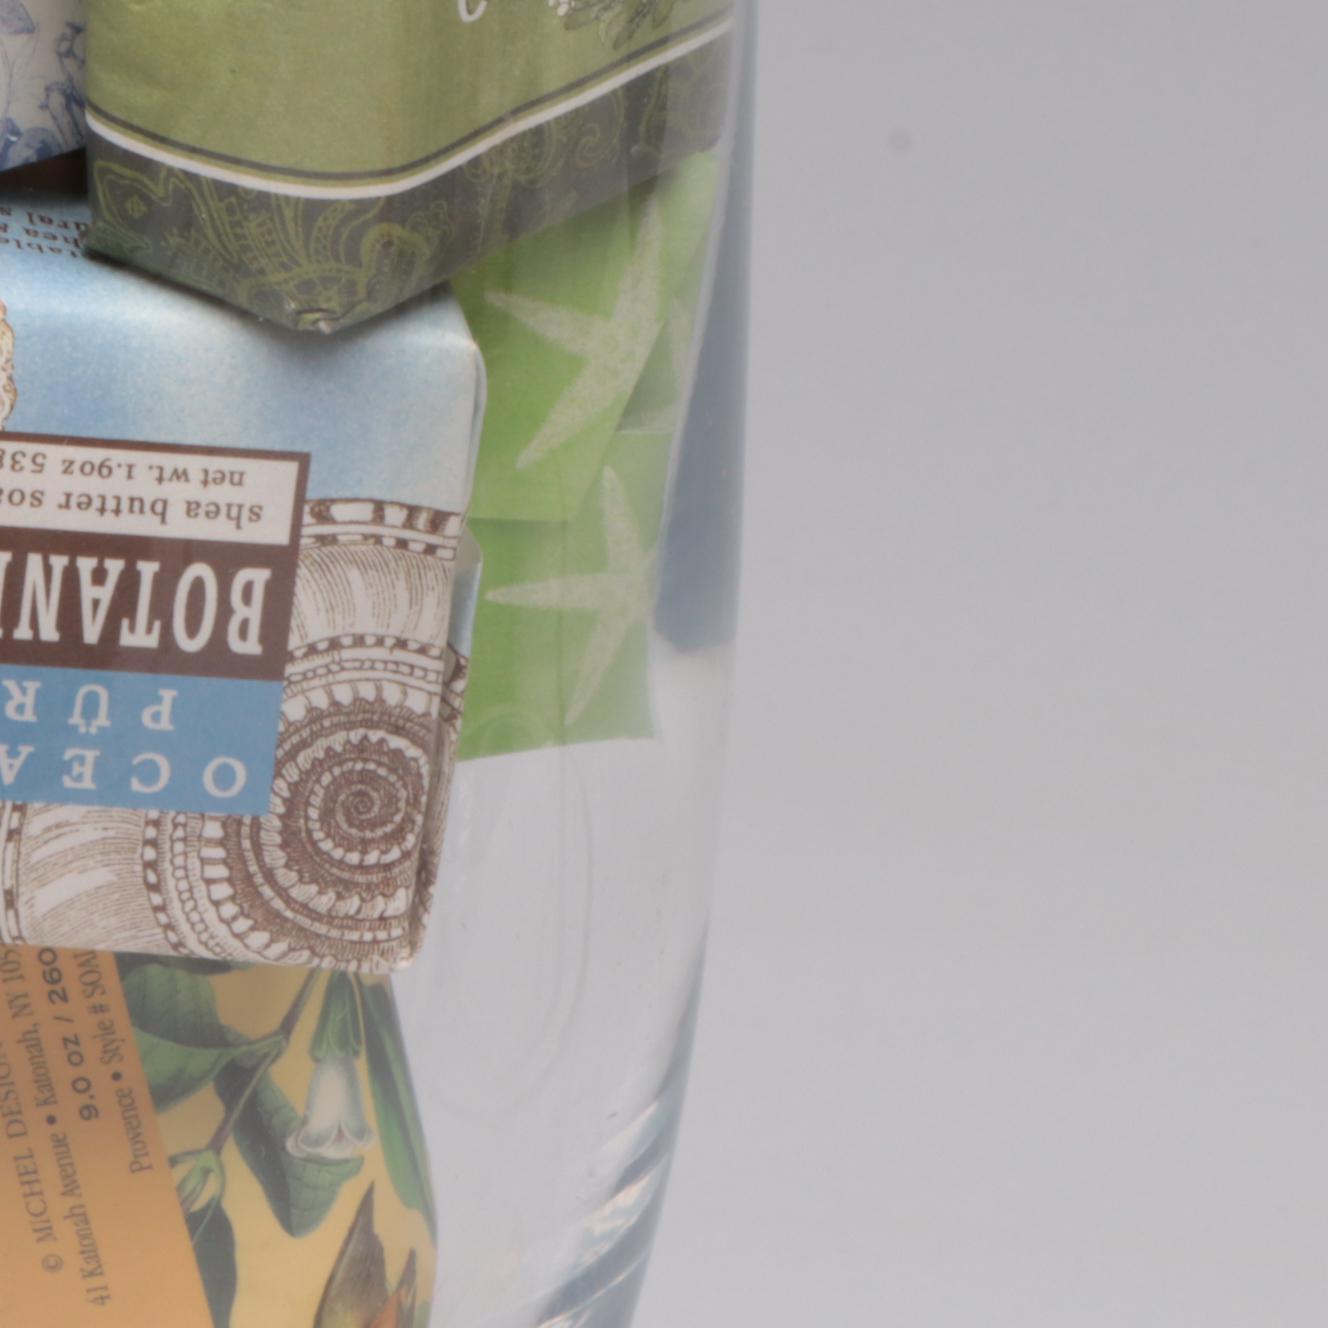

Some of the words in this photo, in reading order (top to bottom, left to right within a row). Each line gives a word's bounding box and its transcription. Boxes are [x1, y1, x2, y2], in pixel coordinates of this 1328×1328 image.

[147, 462, 190, 485] wt.
[202, 467, 246, 489] net
[58, 491, 169, 525] butter
[184, 497, 264, 531] shea
[4, 991, 35, 1020] NY
[87, 1002, 111, 1016] #
[60, 1032, 86, 1068] oz
[91, 1018, 127, 1066] Style
[70, 1075, 100, 1122] 9.0
[114, 1086, 154, 1175] Provence
[49, 1131, 83, 1199] Avenue
[12, 1146, 58, 1244] MICHEL
[61, 1202, 106, 1281] Katonah
